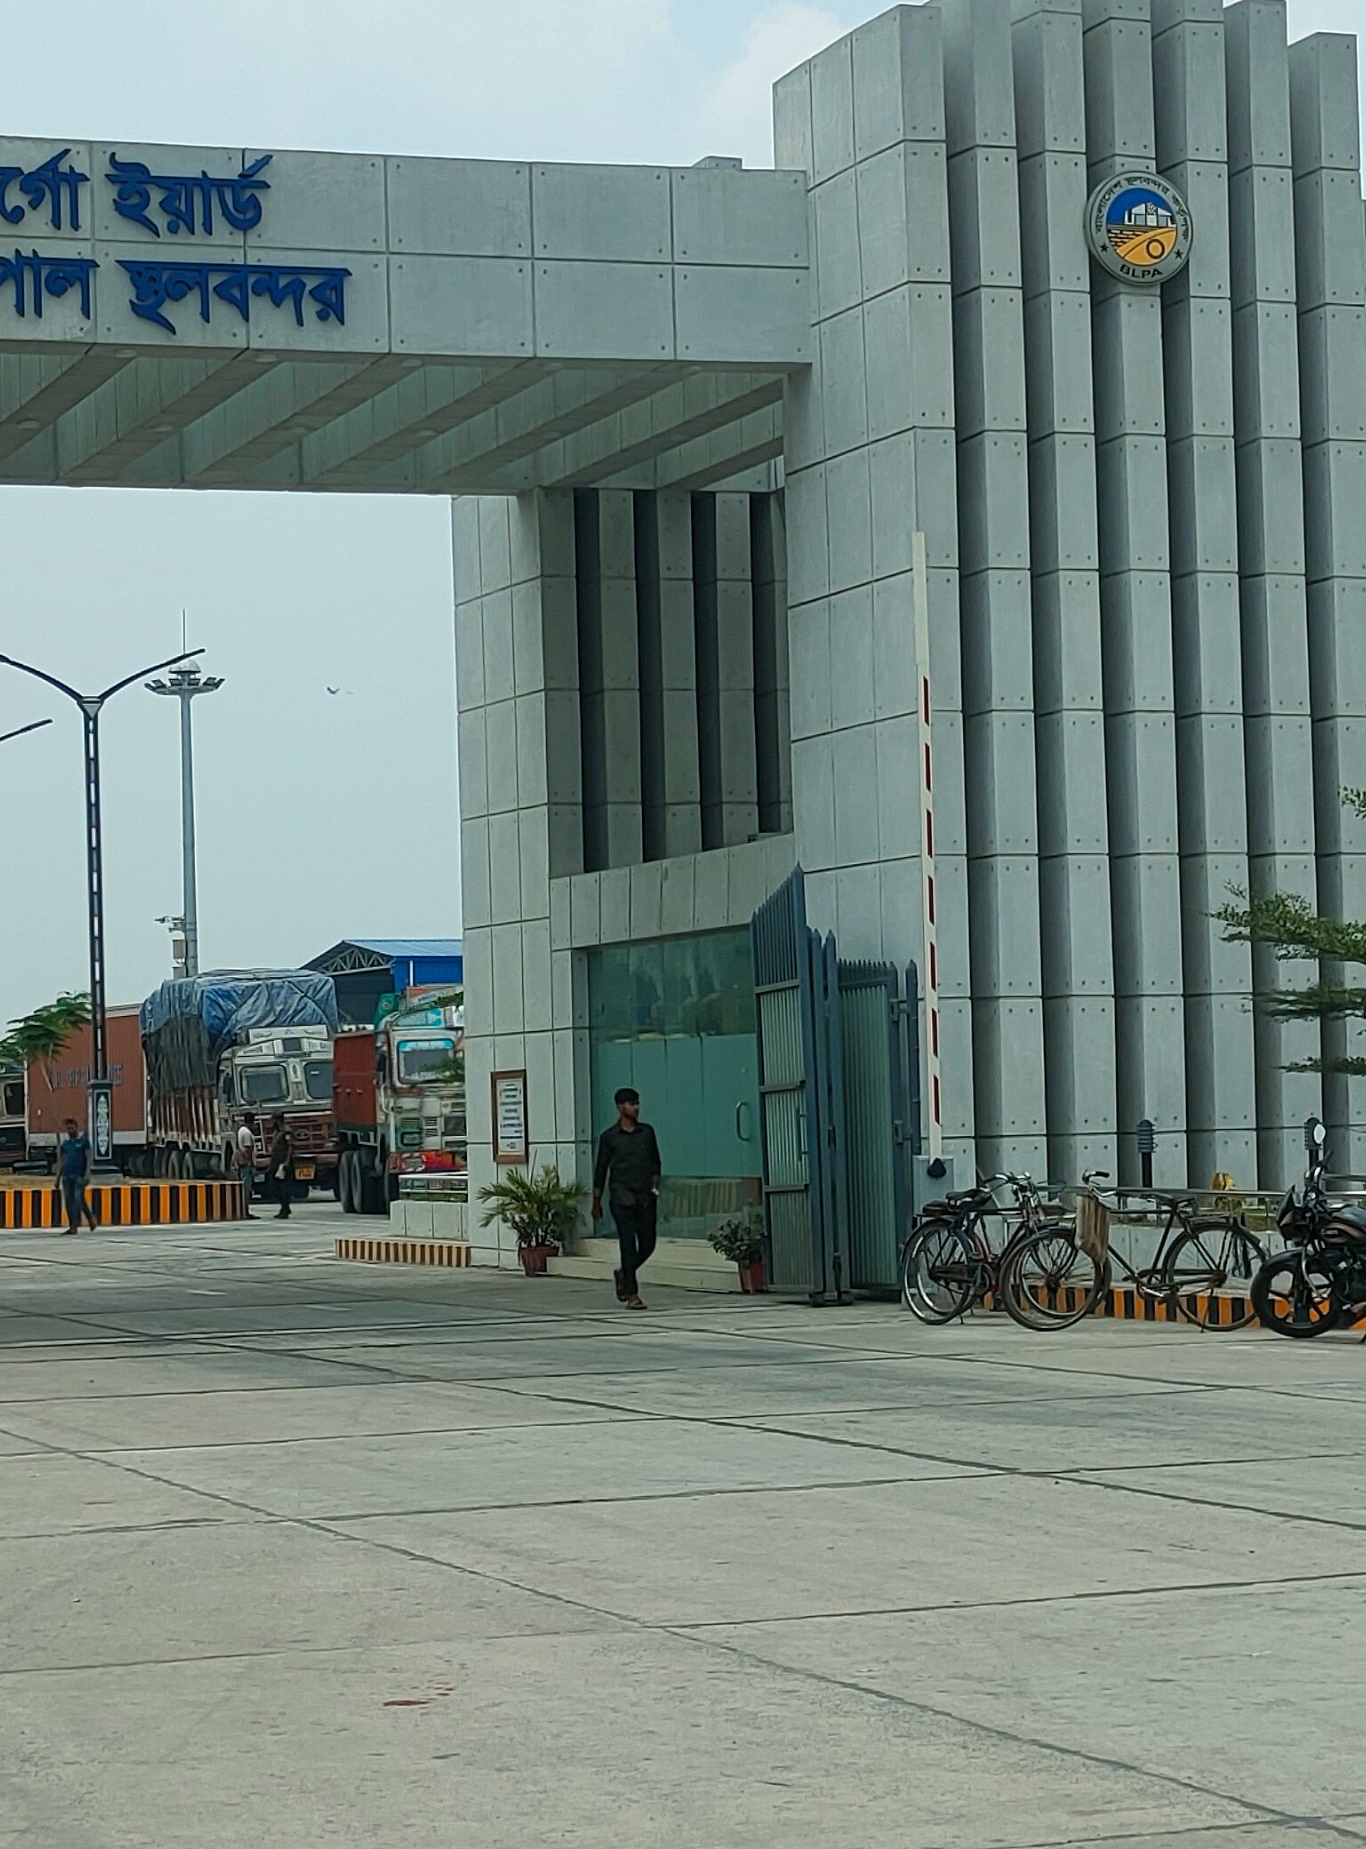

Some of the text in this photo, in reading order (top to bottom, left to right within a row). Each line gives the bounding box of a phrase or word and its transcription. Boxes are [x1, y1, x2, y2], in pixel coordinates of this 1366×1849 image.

[105, 153, 274, 238] ইয়ার্ড
[116, 259, 352, 336] স্থলবন্দর
[1119, 263, 1164, 279] BLPA
